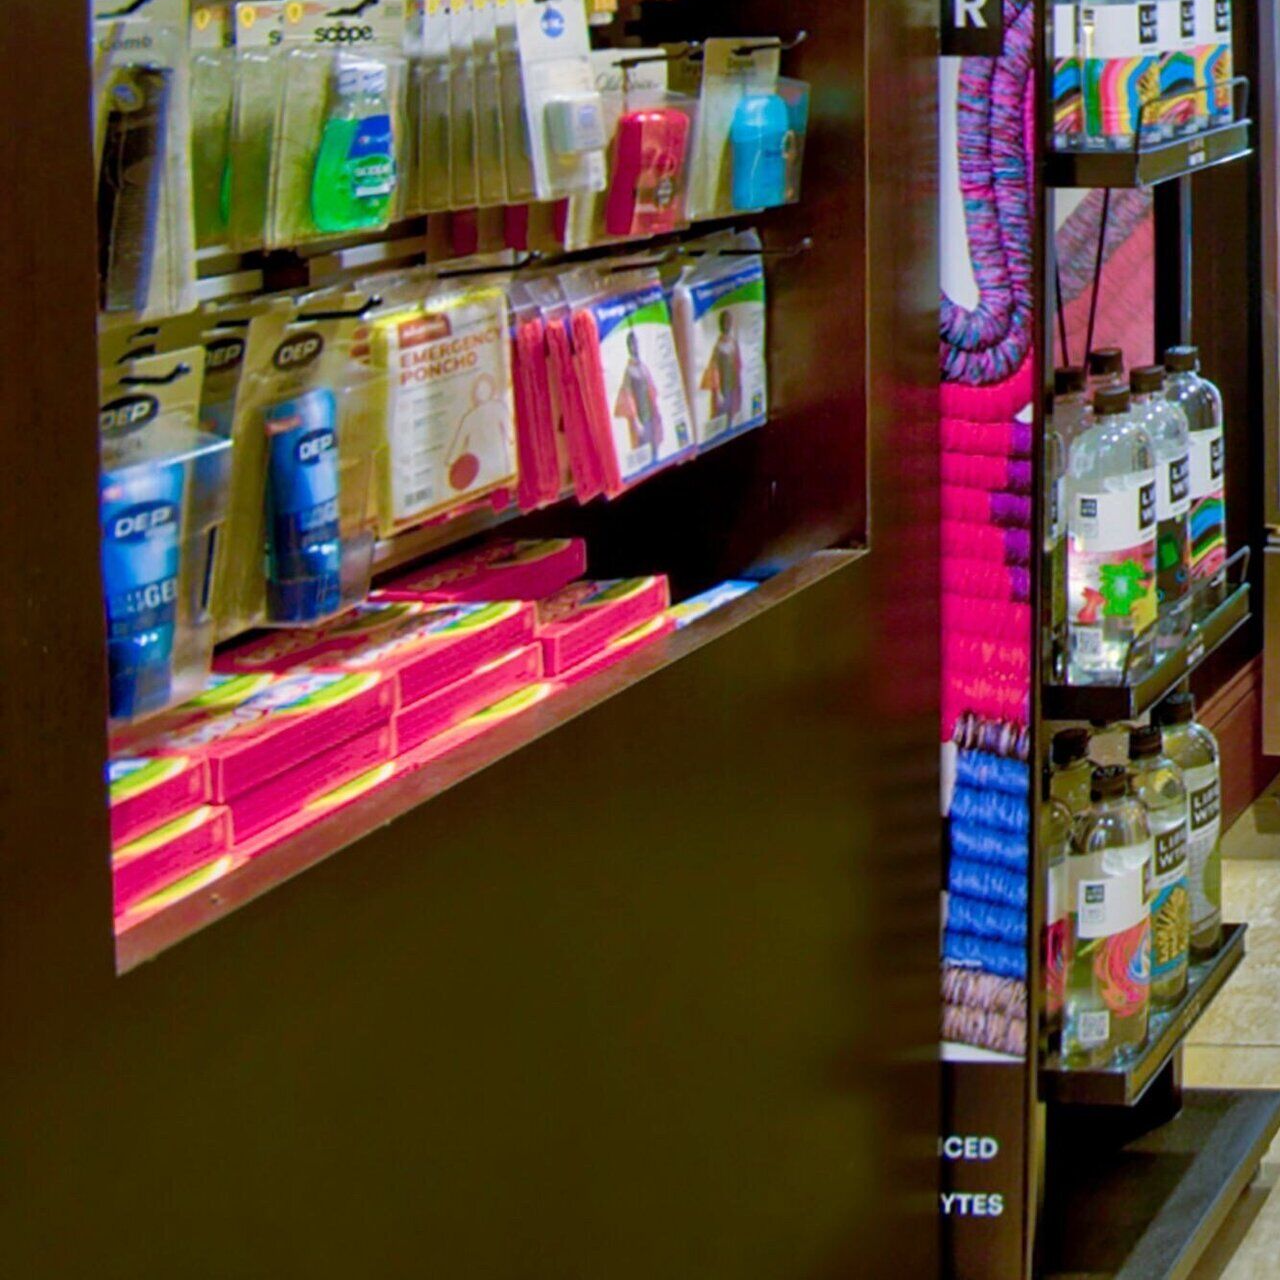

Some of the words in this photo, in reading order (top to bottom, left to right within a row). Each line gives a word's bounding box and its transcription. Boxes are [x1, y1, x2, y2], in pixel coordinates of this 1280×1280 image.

[314, 24, 374, 44] scope
[279, 339, 319, 365] DEP
[299, 431, 333, 460] DEP
[115, 505, 172, 538] DEP
[941, 1136, 998, 1159] CED
